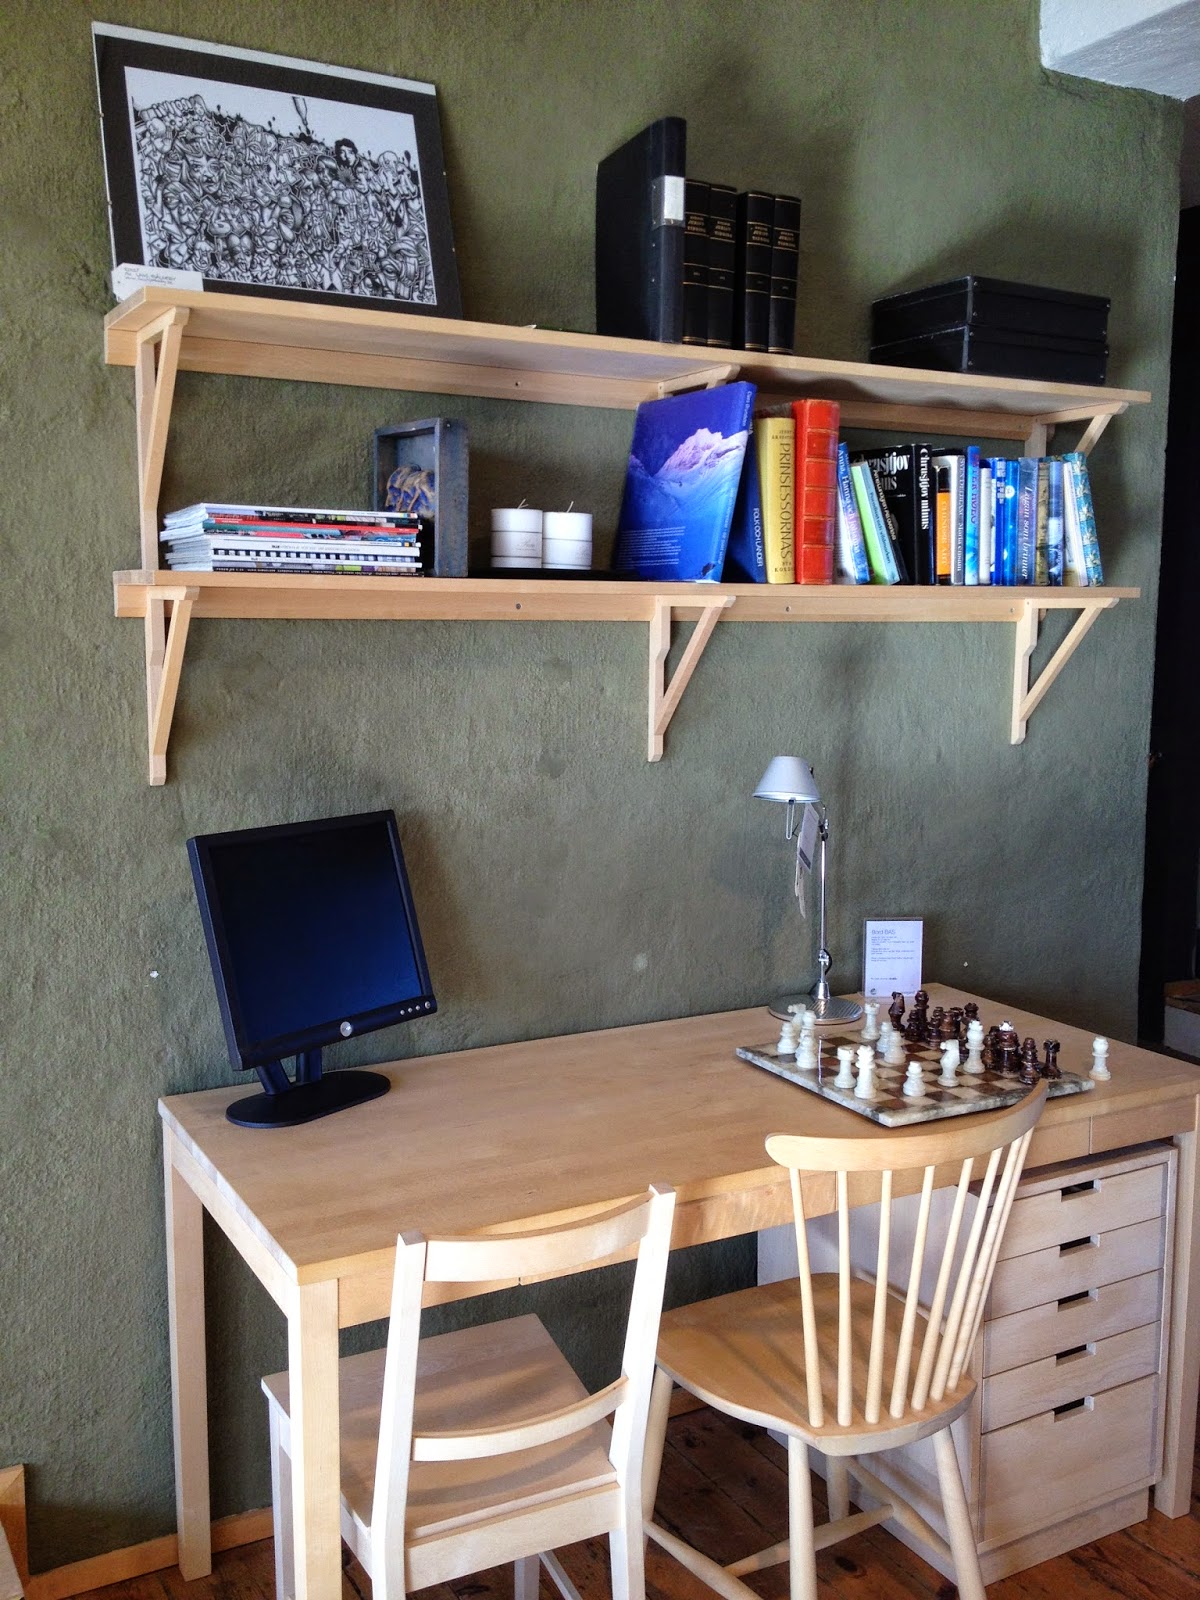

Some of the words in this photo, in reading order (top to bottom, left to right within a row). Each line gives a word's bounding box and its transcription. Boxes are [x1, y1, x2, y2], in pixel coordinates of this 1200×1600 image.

[918, 448, 930, 499] Chrusjtjov
[779, 442, 793, 560] PRINSESSORNAS
[921, 499, 931, 530] minns
[754, 525, 762, 541] OCH
[1022, 519, 1030, 540] som
[1021, 541, 1032, 580] brinner
